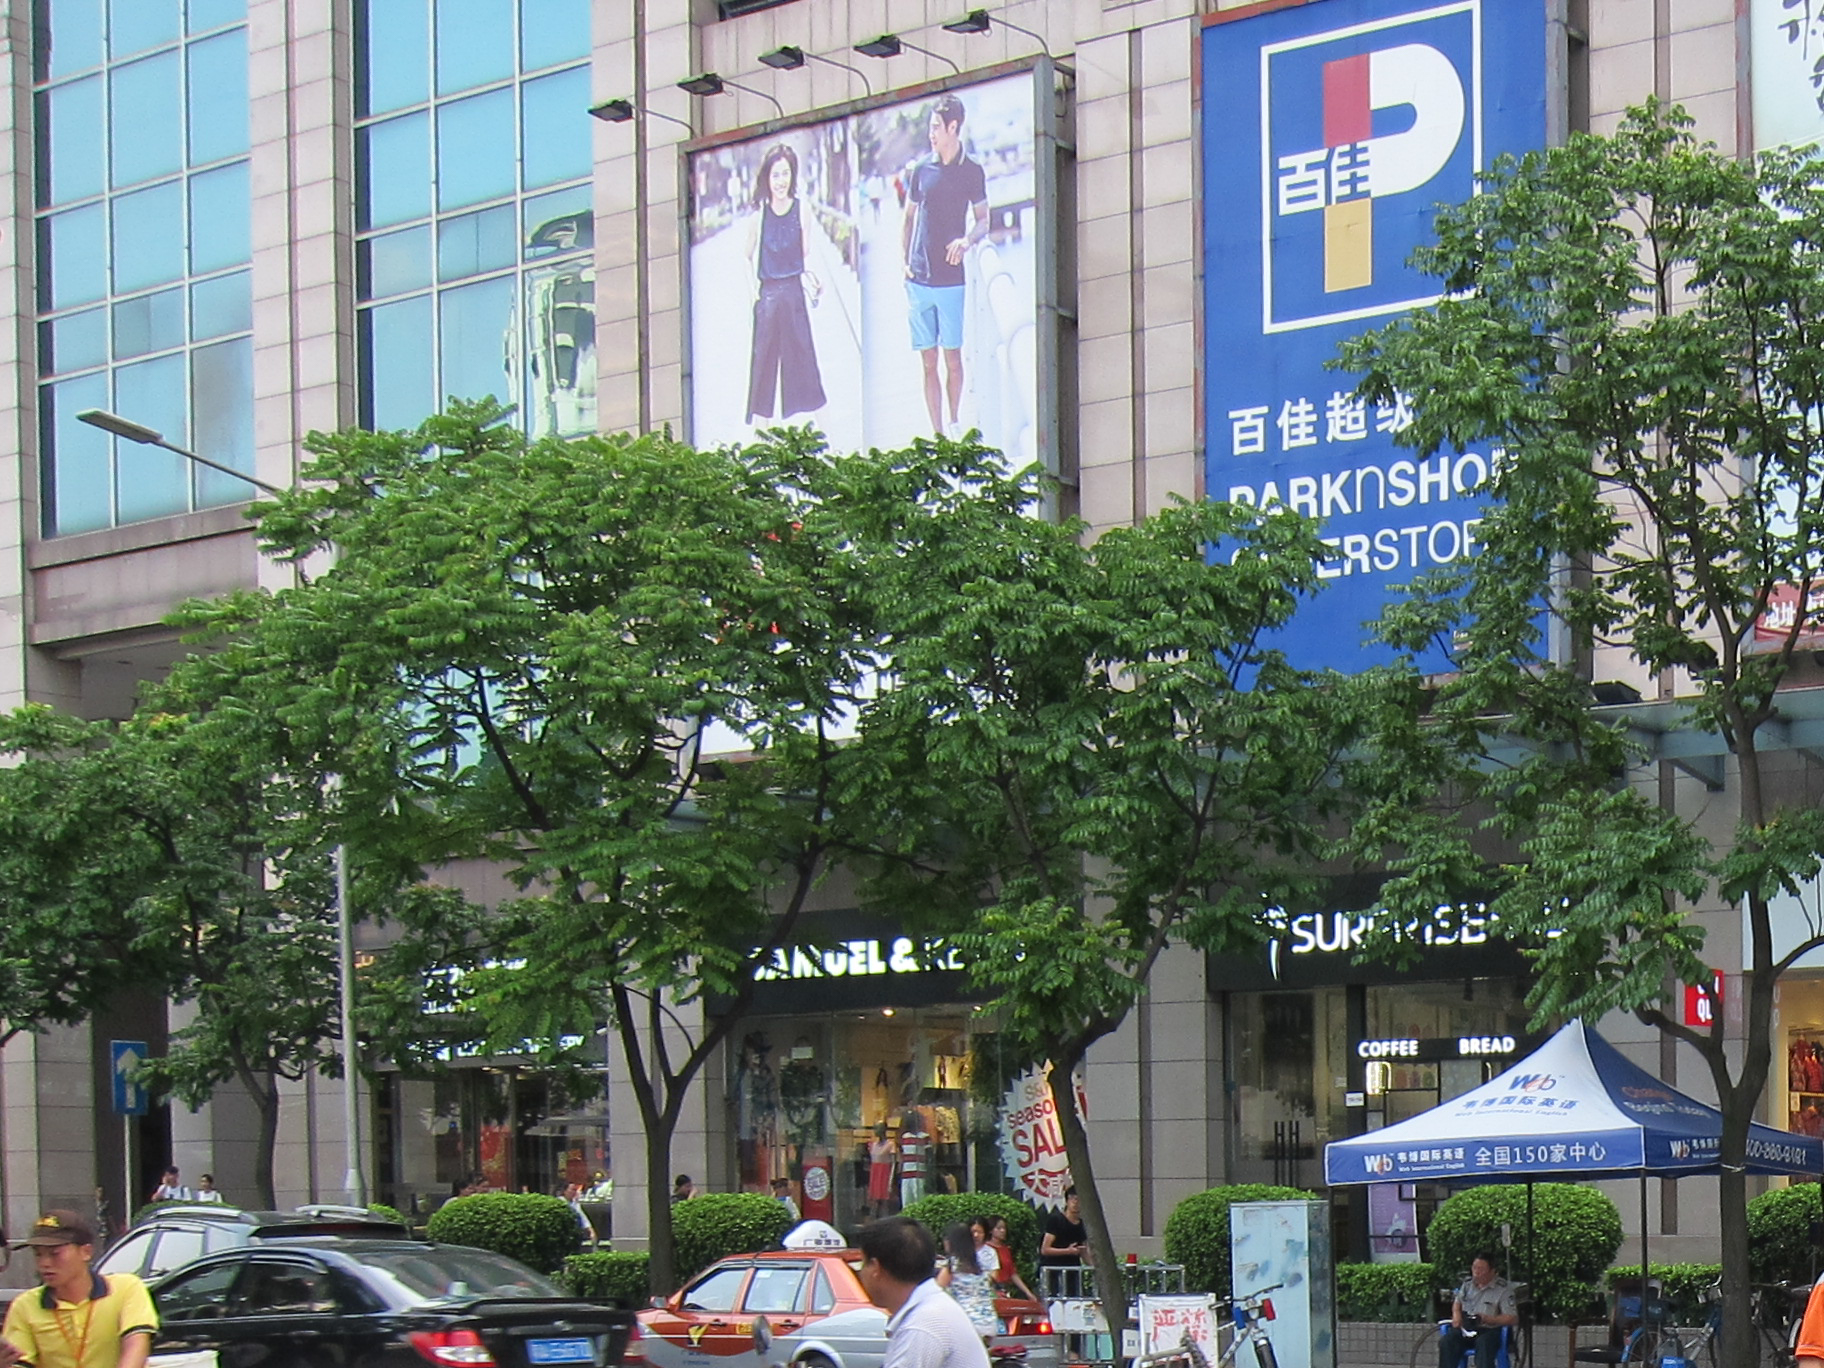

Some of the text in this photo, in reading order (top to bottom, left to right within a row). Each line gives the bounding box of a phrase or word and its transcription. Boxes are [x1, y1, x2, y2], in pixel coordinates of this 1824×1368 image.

[1278, 141, 1371, 216] 百佳
[889, 936, 920, 975] &
[1358, 1036, 1516, 1058] COFFEE BREAD
[1007, 1099, 1054, 1129] seaso
[1012, 1118, 1067, 1168] SAL
[1474, 1141, 1606, 1166] 全国150家中心
